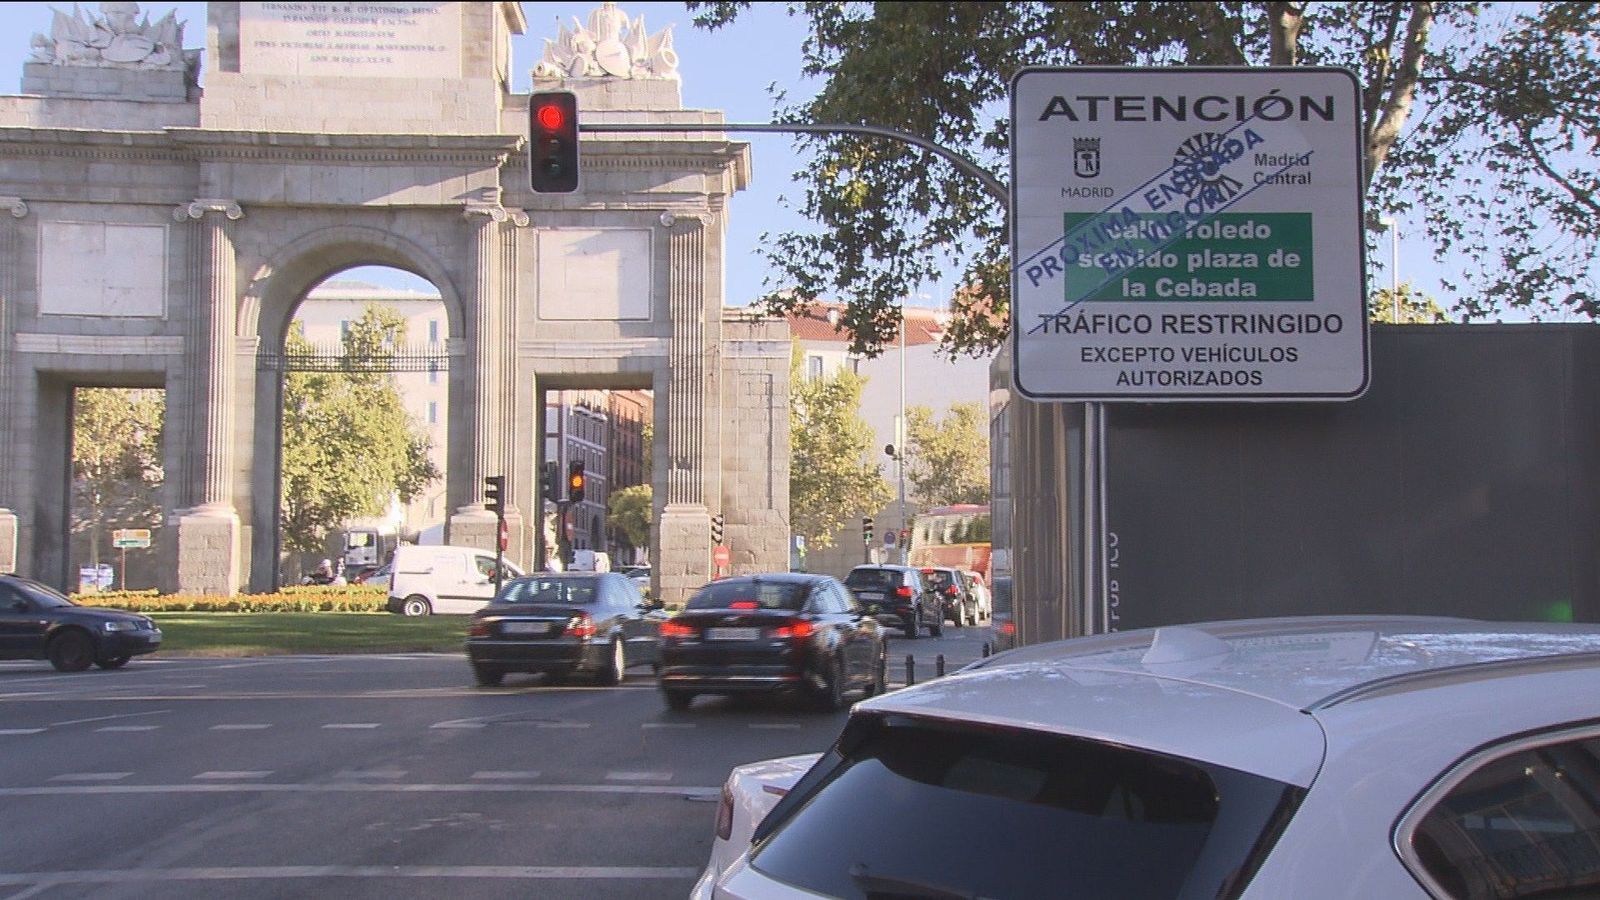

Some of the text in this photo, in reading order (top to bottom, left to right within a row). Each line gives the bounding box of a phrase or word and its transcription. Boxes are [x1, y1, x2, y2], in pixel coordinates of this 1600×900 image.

[1038, 89, 1335, 122] ATENCIÓN
[1254, 153, 1310, 167] Madrid
[1253, 171, 1312, 185] Central
[1061, 187, 1114, 198] MADRID
[1186, 220, 1272, 239] Toledo
[1187, 249, 1259, 272] plaza
[1267, 249, 1301, 268] de
[1122, 277, 1257, 298] la Cebada
[1038, 309, 1344, 335] TRÁFICO RESTRINGIDO
[1080, 344, 1299, 364] EXCEPTO VEHÍCULOS
[1115, 370, 1264, 387] AUTORIZADOS
